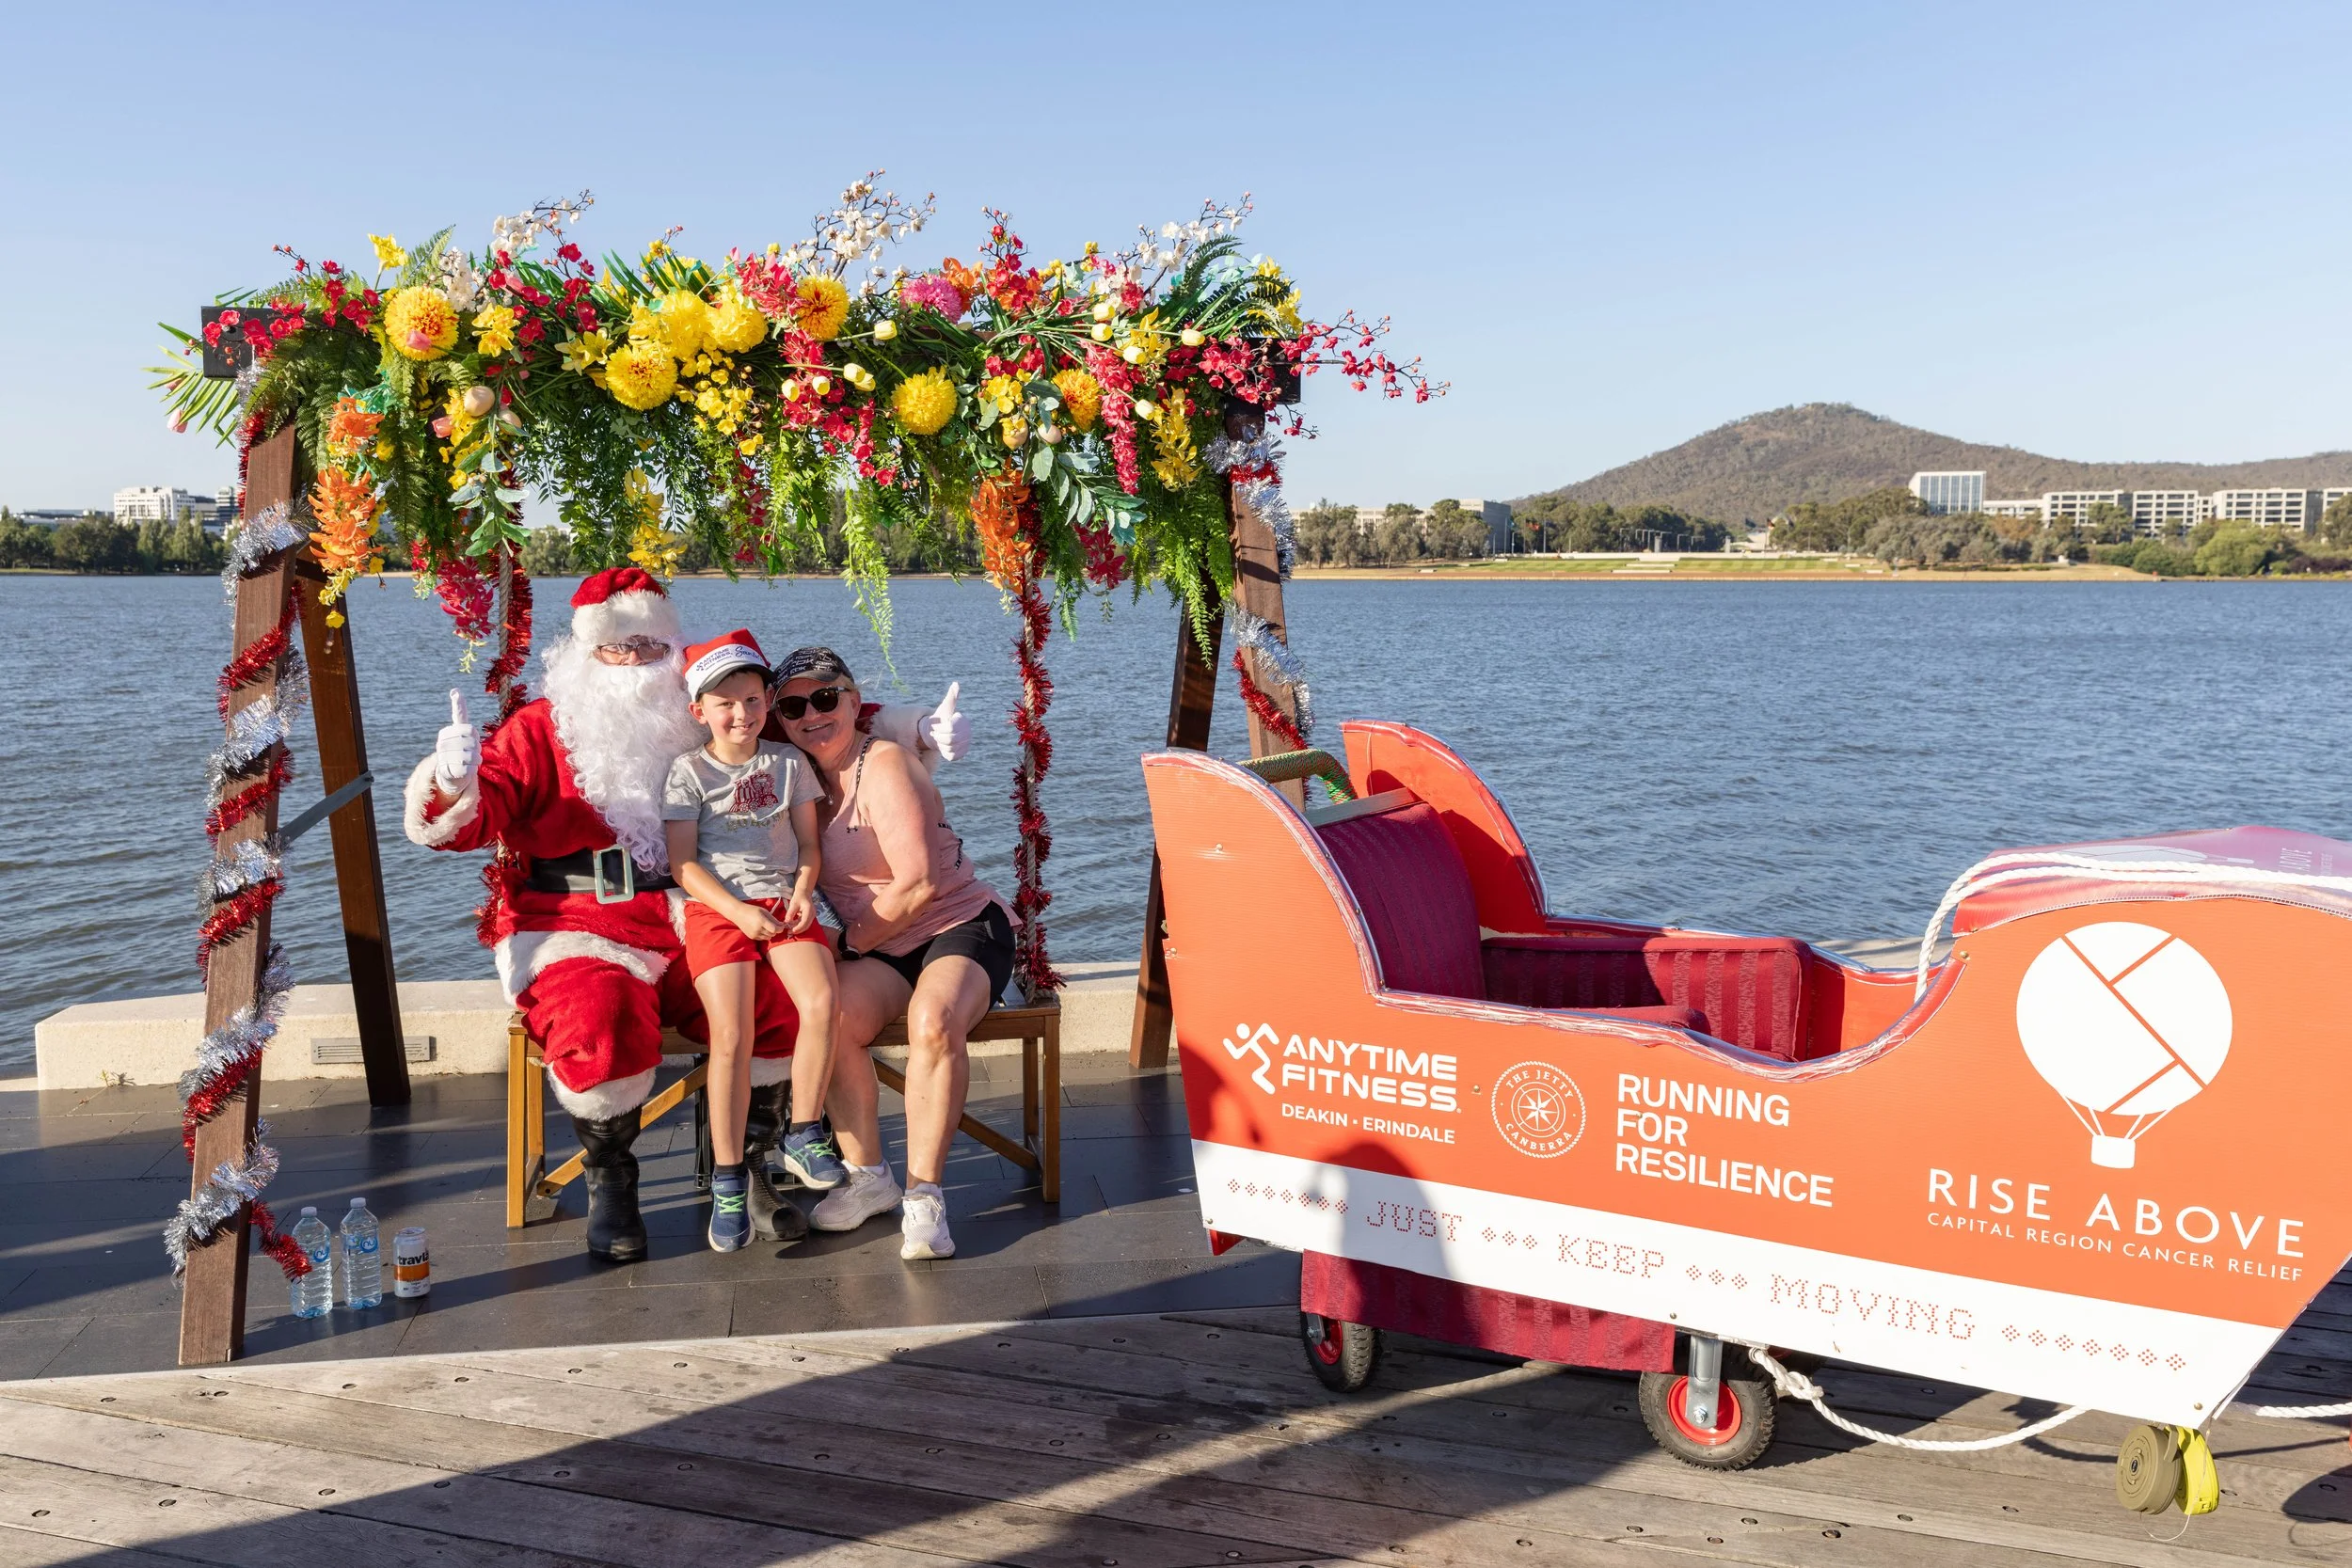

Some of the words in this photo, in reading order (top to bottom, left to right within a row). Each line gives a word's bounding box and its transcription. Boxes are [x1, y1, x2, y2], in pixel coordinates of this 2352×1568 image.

[703, 647, 730, 664] ANYTIME
[1282, 1034, 1457, 1082] ANYTIME
[1505, 1070, 1530, 1088] THE
[1535, 1069, 1574, 1099] JETTY
[1618, 1073, 1789, 1127] RUNNING
[1281, 1102, 1348, 1127] DEAKIN
[1362, 1117, 1455, 1145] ERINDALE
[1505, 1123, 1572, 1151] CANBERRA
[1616, 1108, 1689, 1147] FOR
[1615, 1143, 1834, 1208] RESILIENCE
[1929, 1168, 2051, 1221] RISE
[2085, 1194, 2304, 1259] ABOVE
[1367, 1201, 1462, 1241] JUST
[1558, 1234, 1664, 1277] KEEP
[1771, 1273, 1975, 1339] MOVING
[1927, 1212, 2014, 1238] CAPITAL
[2026, 1227, 2112, 1254] REGION
[2122, 1243, 2214, 1269] CANCER
[2228, 1259, 2302, 1282] RELIEF
